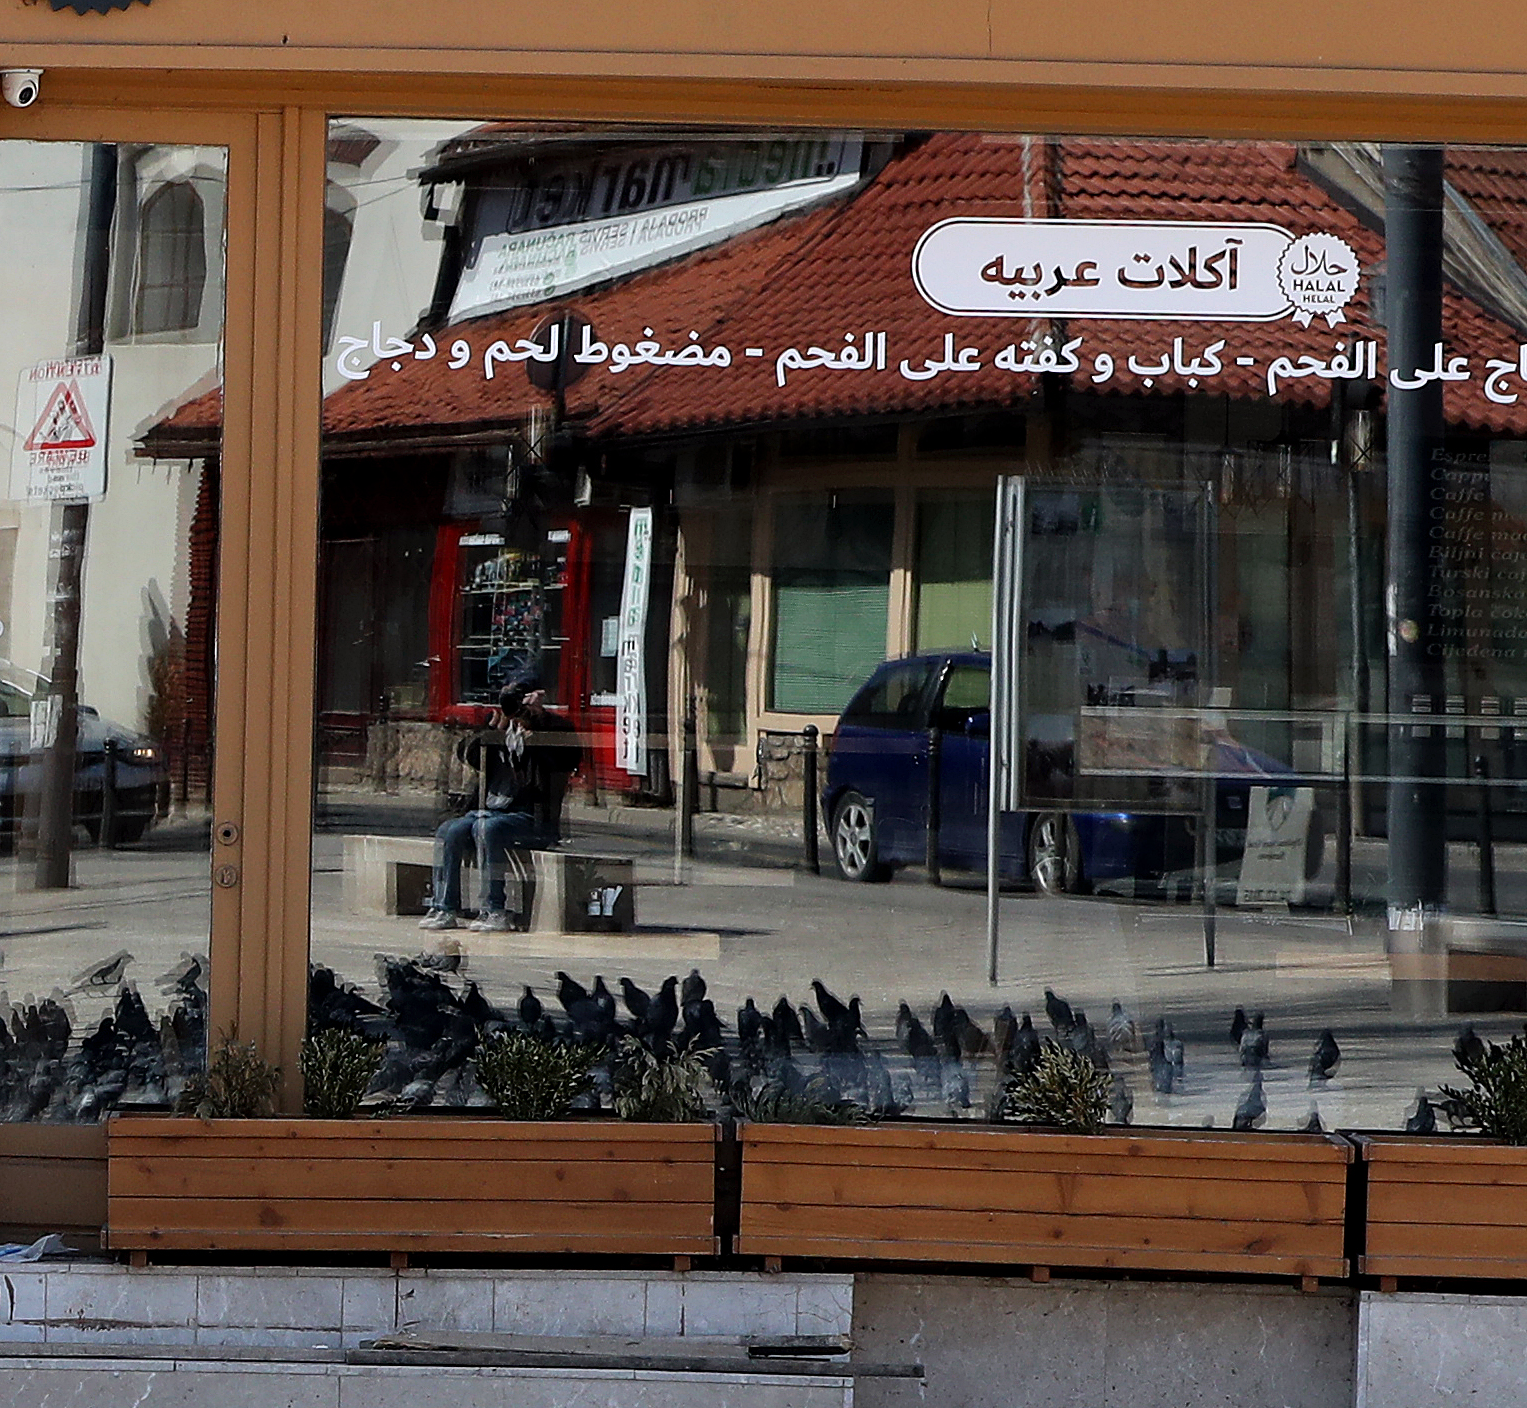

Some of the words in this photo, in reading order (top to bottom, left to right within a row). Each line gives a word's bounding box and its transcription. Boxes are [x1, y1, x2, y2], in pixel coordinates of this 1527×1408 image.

[1116, 237, 1243, 292] آكلات
[1289, 243, 1348, 279] حلال
[1292, 279, 1346, 294] HALAL
[1302, 293, 1336, 304] HELAL
[337, 320, 436, 380] دجاج
[448, 338, 472, 369] و
[484, 324, 559, 380] لحم
[574, 324, 732, 373] مضغوط
[776, 331, 887, 387] الفحم
[900, 333, 982, 381] على
[994, 336, 1083, 373] كفته
[1092, 354, 1115, 383] و
[1127, 337, 1226, 389] كباب
[1267, 340, 1377, 396] الفحم
[1390, 342, 1471, 390] على
